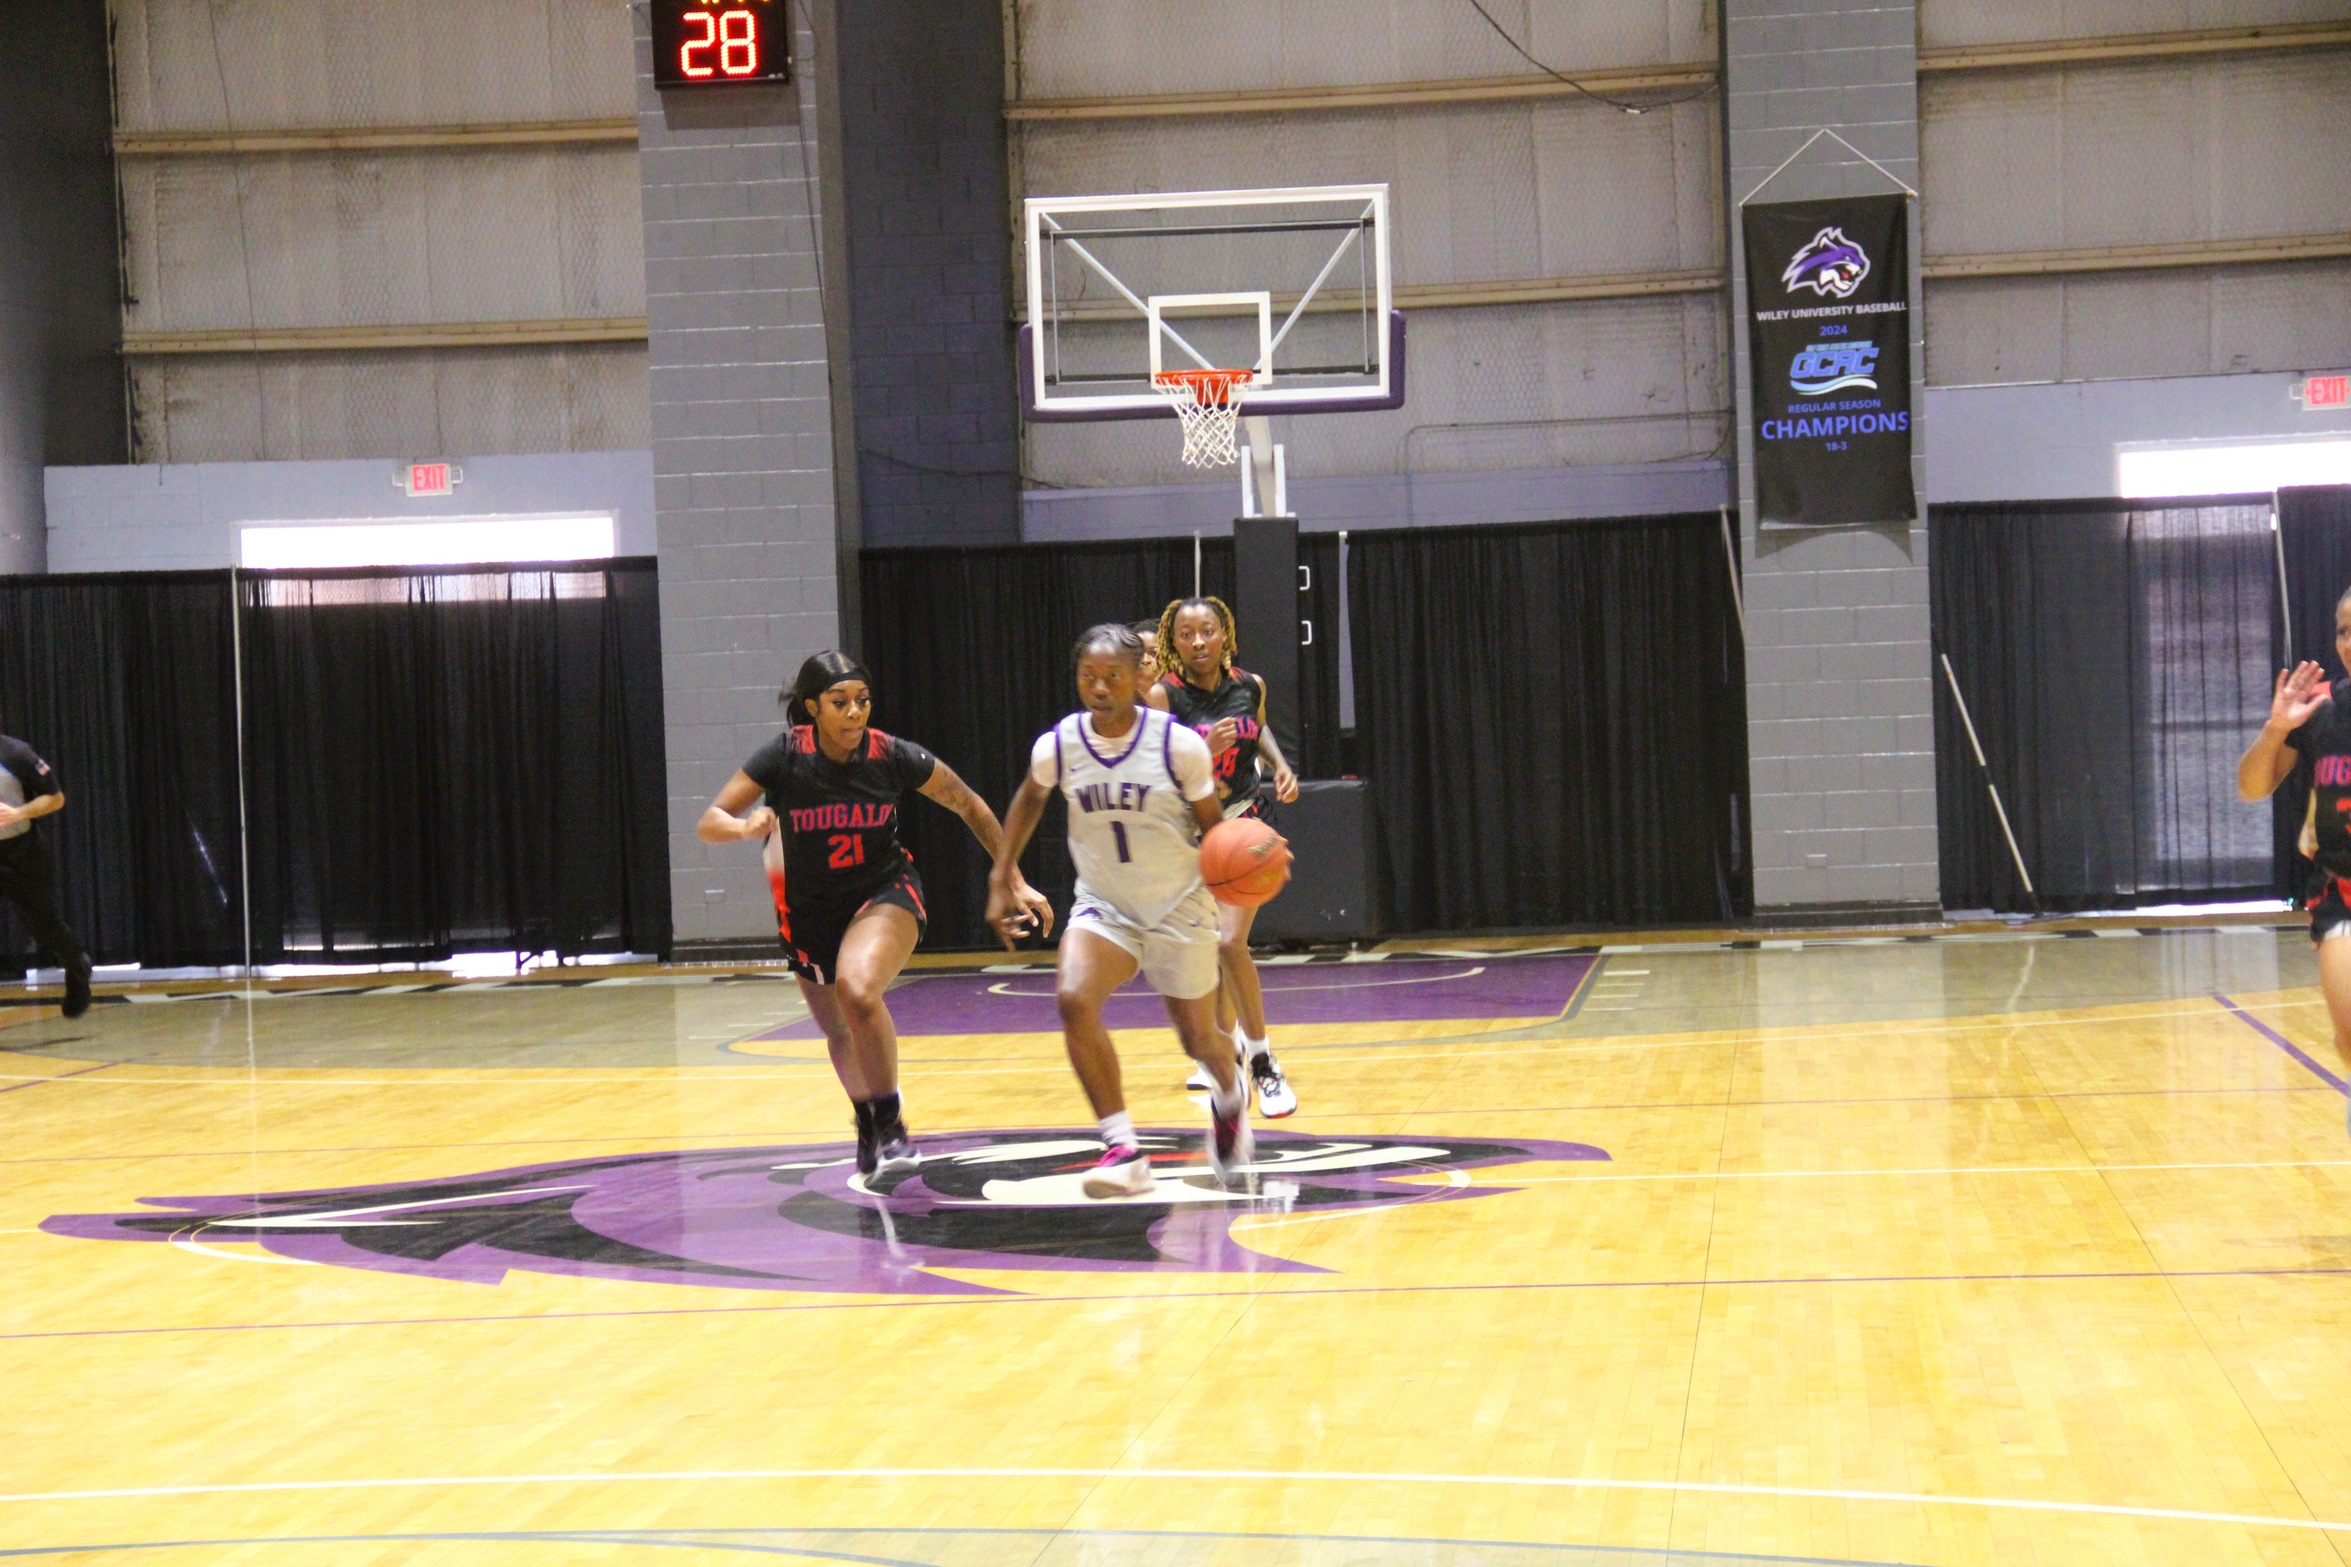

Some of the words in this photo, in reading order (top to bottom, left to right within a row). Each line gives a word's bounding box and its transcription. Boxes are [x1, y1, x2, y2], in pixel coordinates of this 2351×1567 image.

[681, 10, 757, 77] 28
[1757, 309, 1790, 321] WILEY
[1792, 305, 1854, 318] UNIVERSITY
[1855, 301, 1907, 314] BASEBALL
[1820, 324, 1848, 336] 2024
[2309, 376, 2347, 405] EXIT
[1788, 401, 1837, 414] REGULAR
[1839, 399, 1881, 411] SEASON
[1761, 411, 1909, 440] CHAMPIONS
[1825, 441, 1848, 451] 18-3
[411, 463, 447, 492] EXIT
[1075, 781, 1152, 813] WILEY
[828, 833, 865, 869] 21
[1110, 820, 1131, 863] 1
